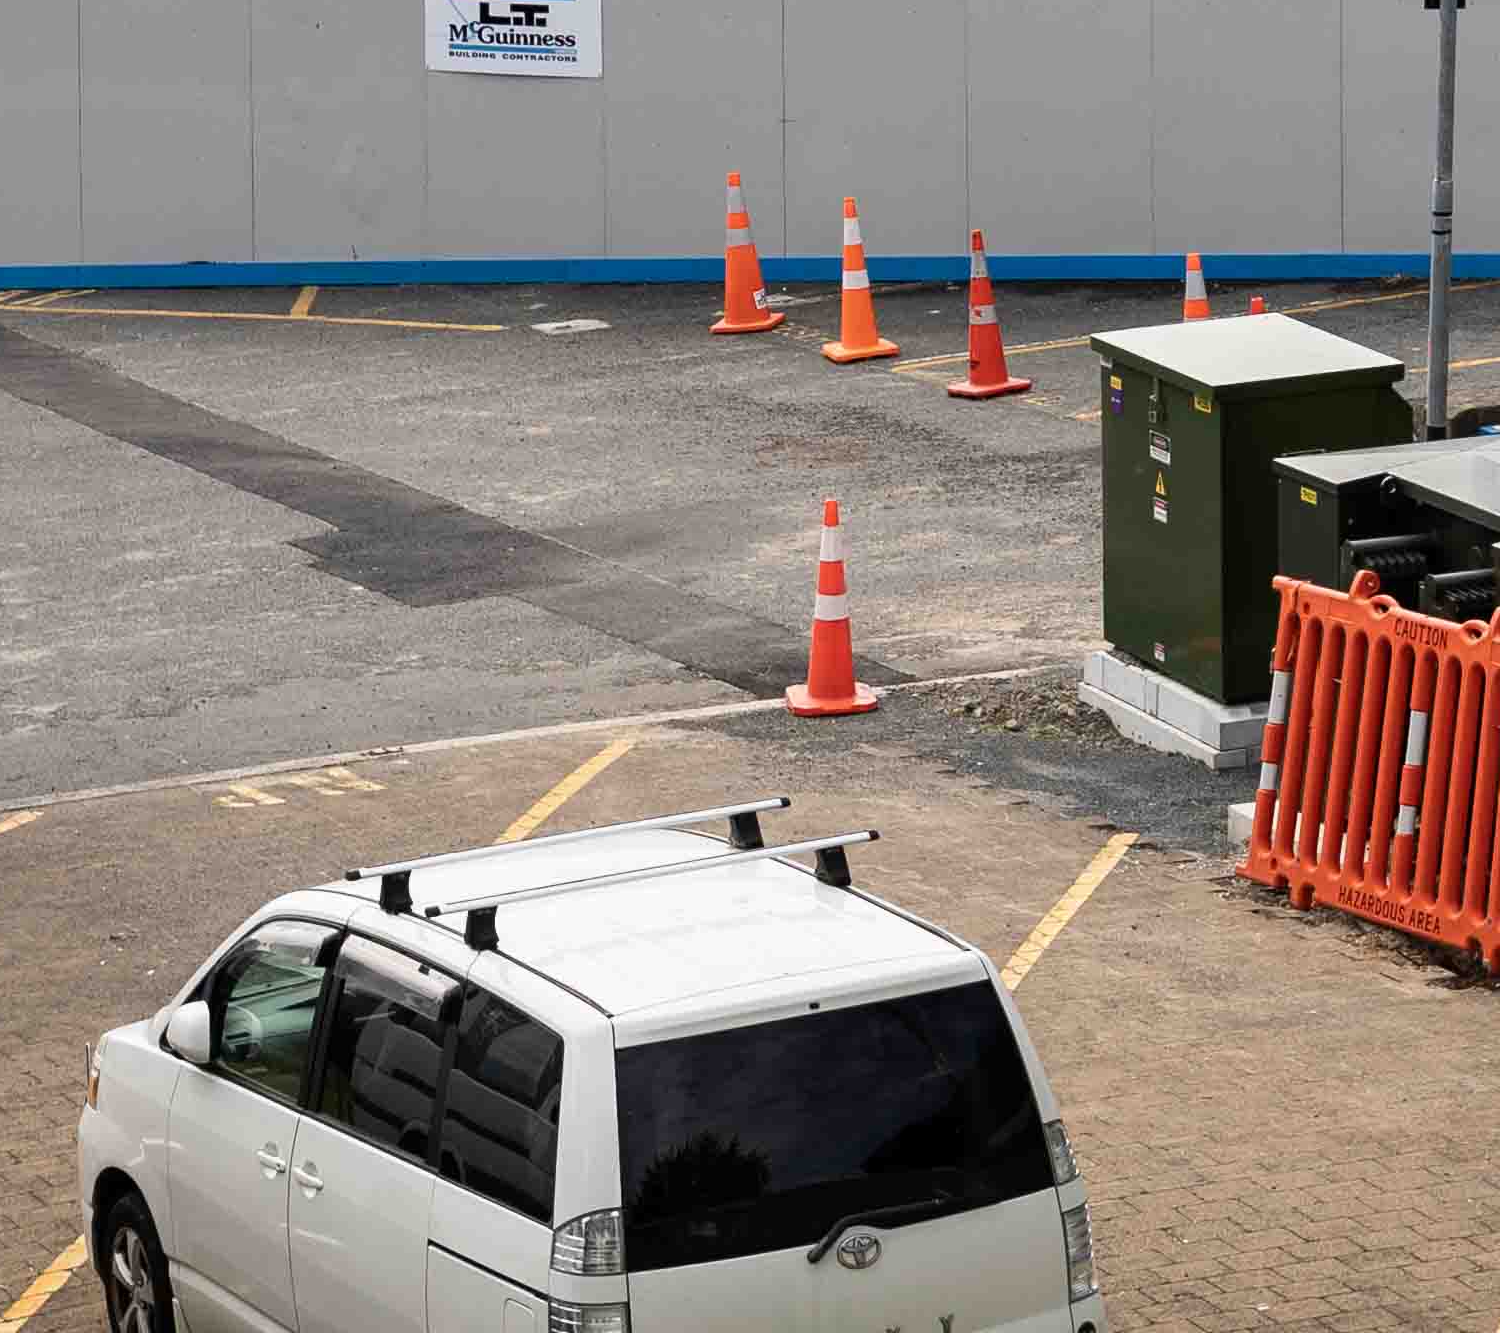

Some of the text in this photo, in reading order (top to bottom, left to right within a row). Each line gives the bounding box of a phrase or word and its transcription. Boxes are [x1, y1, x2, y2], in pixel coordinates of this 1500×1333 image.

[478, 1, 550, 28] L.T.
[448, 20, 577, 49] McGuinness
[448, 50, 578, 63] BUILDING CONTRACTORS
[1393, 617, 1449, 648] CAUTION
[1338, 884, 1441, 934] HAZARDOUS AREA
